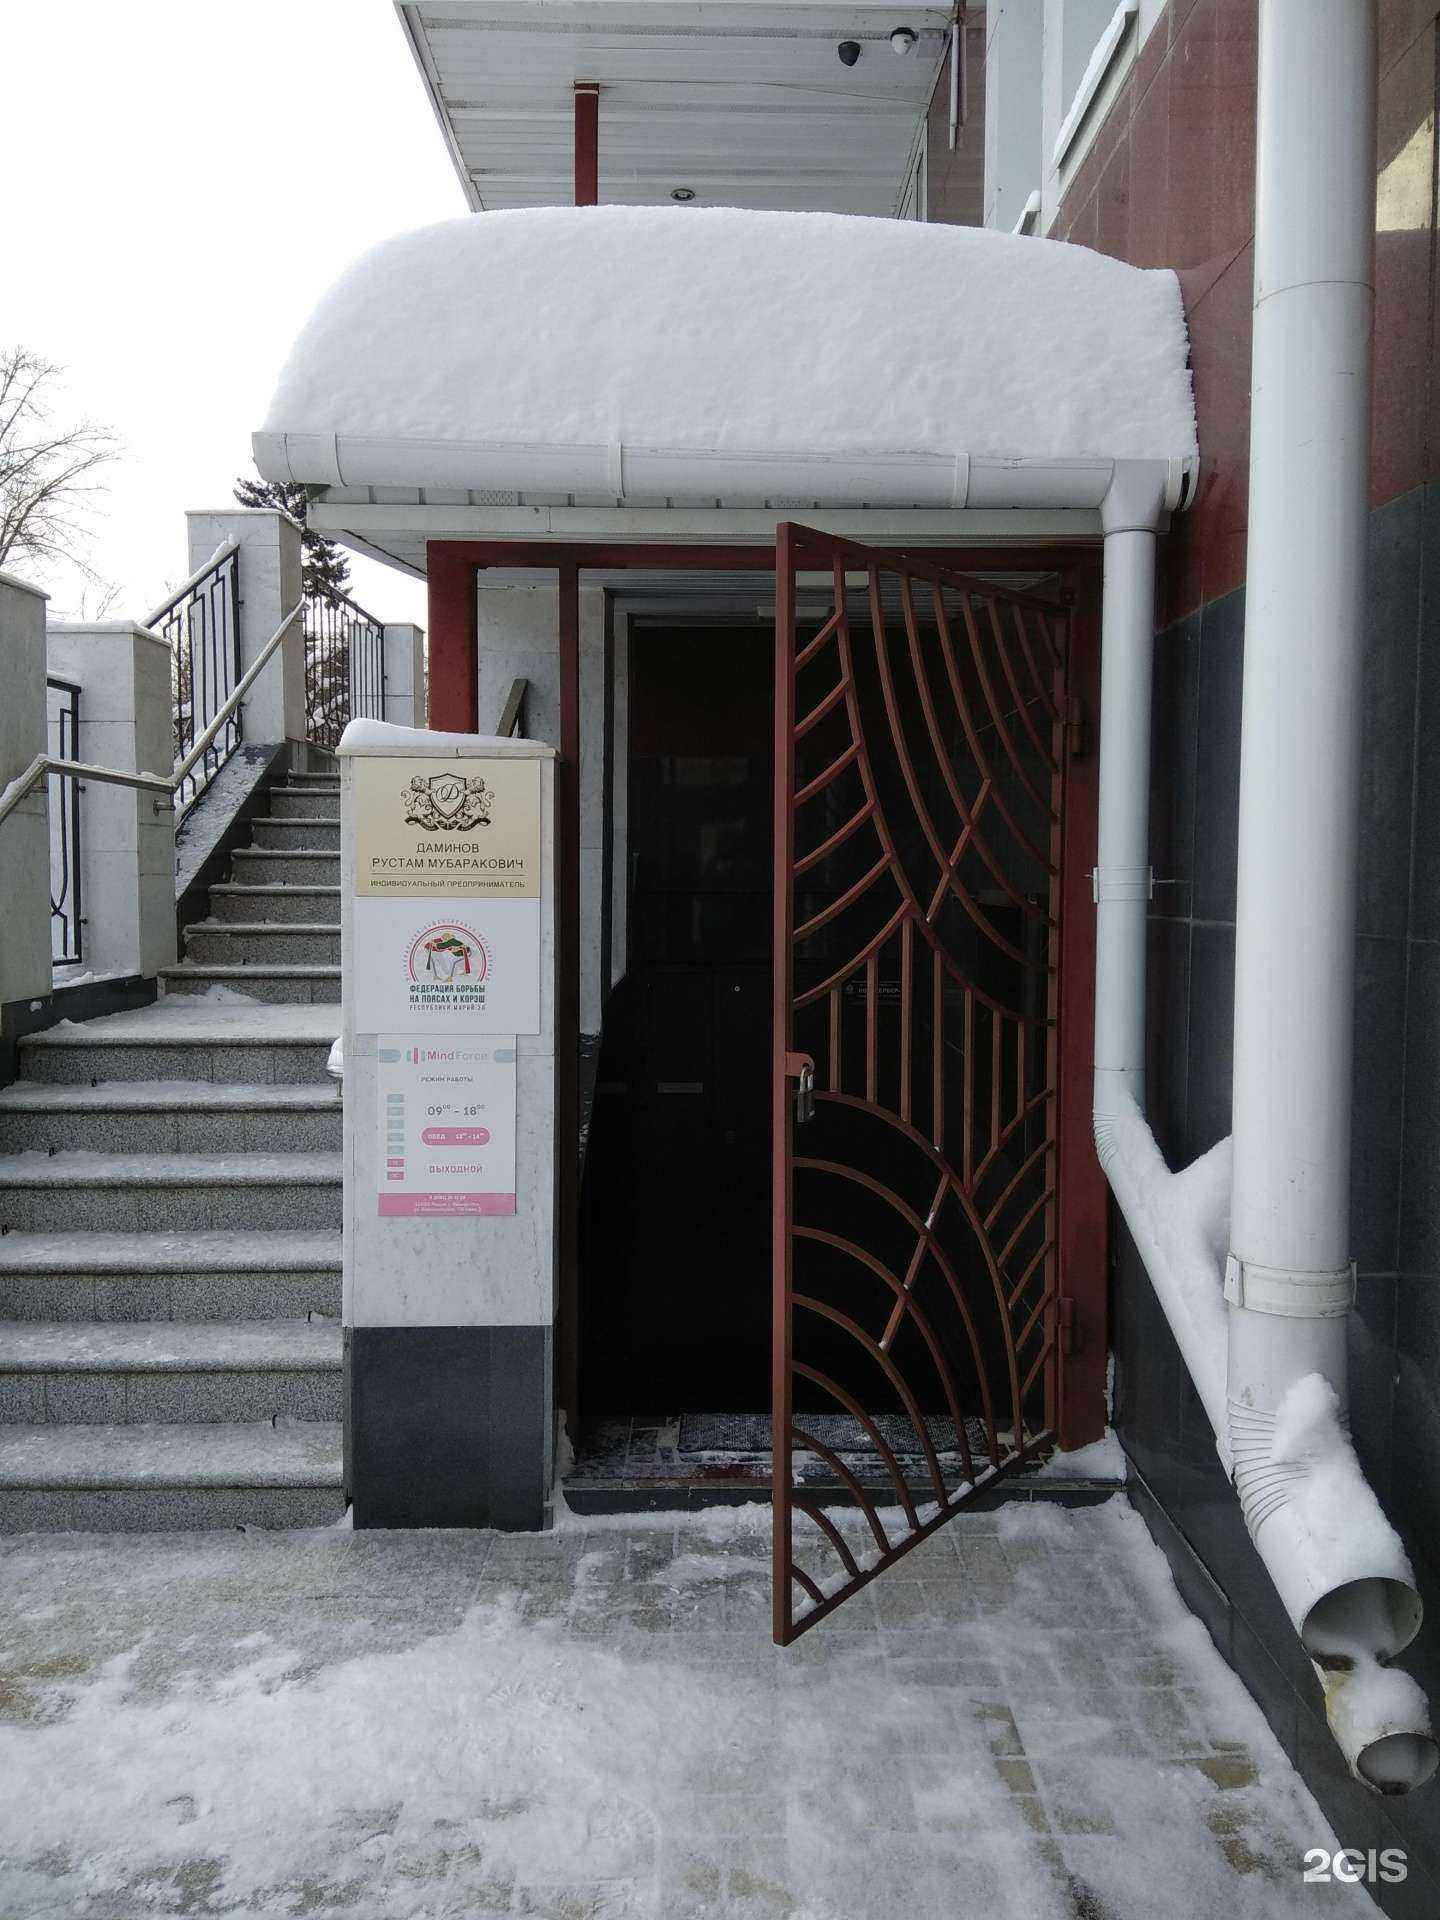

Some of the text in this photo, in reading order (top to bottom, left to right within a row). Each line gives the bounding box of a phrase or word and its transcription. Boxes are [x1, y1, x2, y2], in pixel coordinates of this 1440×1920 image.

[416, 843, 480, 854] ДАМИНОВ
[372, 857, 524, 869] РУСТАМ МУБАРАКОВИЧ
[370, 879, 525, 889] ИНДИВИДУАЛЬНЫЙ ПРЕДПРИНИМАТЕЛЬ
[409, 984, 486, 993] ФЕДЕРАЦИЯ БОРЬБЫ
[409, 994, 419, 1003] НА
[422, 994, 450, 1003] ПОЯСАХ
[453, 994, 458, 1003] И
[429, 1163, 483, 1174] ВЫХОДНОЙ
